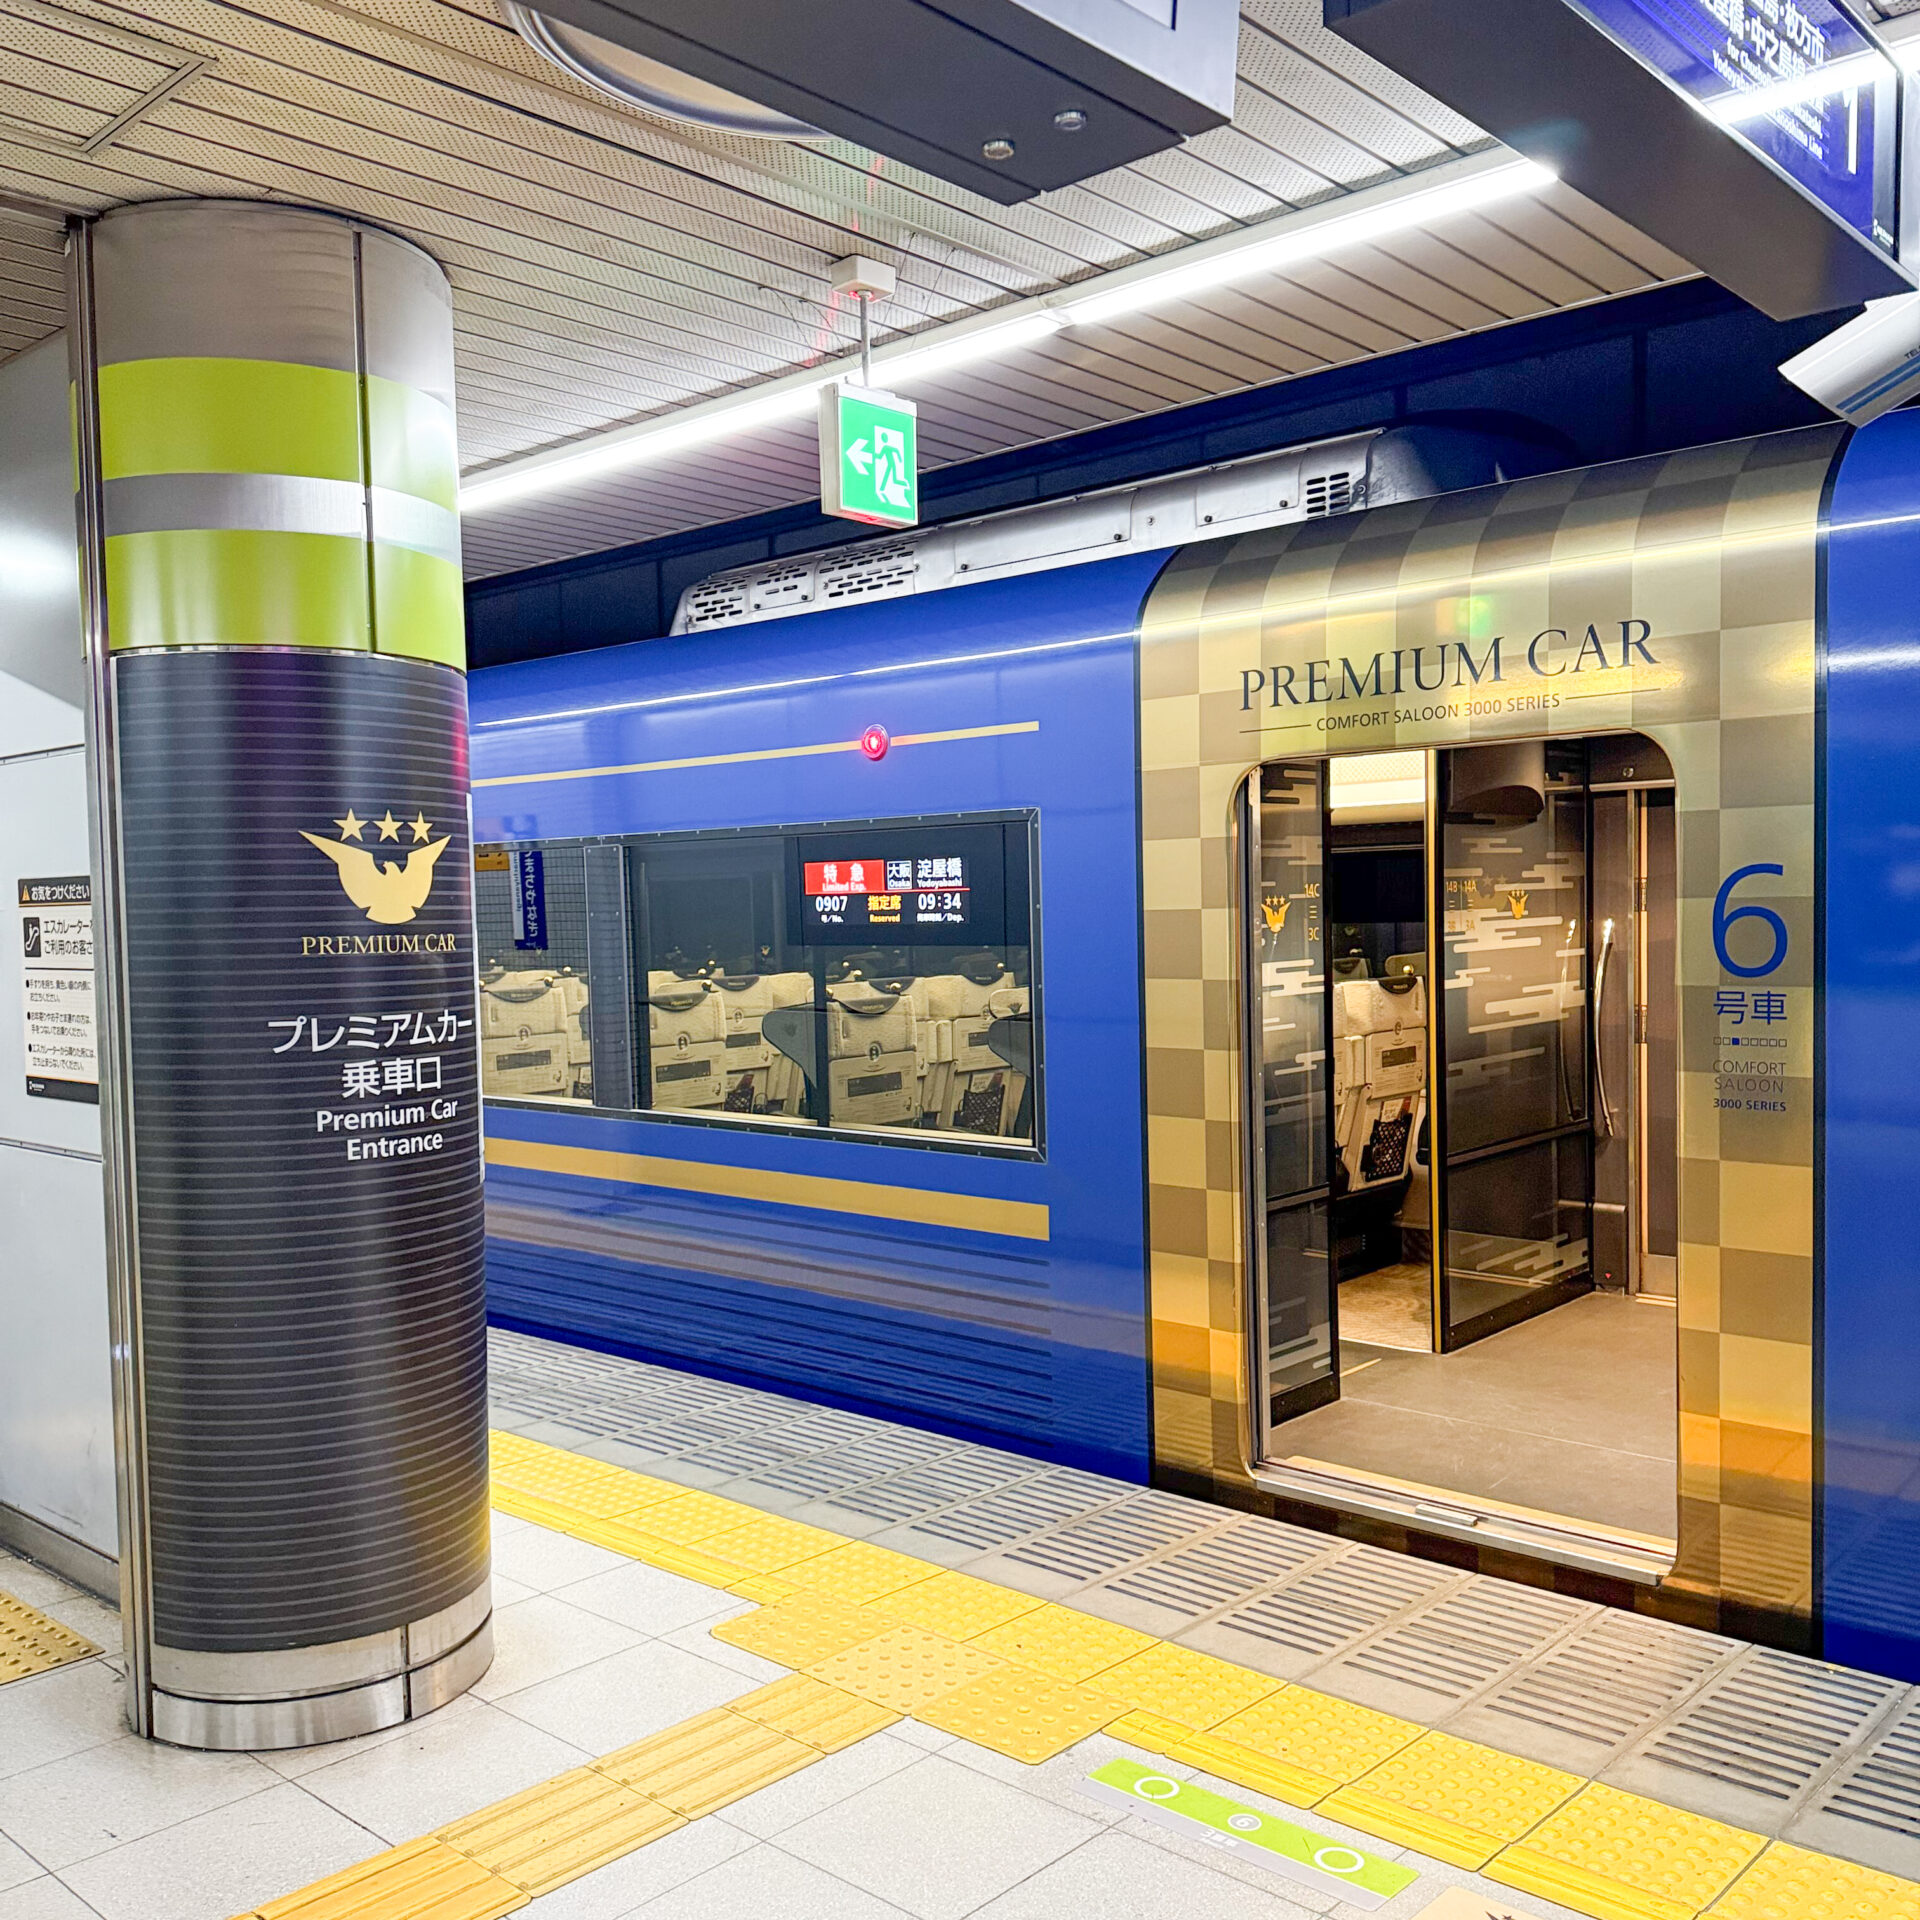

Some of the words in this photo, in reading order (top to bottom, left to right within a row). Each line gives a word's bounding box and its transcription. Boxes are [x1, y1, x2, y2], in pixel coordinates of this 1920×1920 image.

[1727, 36, 1740, 61] for
[1239, 636, 1507, 711] PREMIUM
[1527, 619, 1661, 677] CAR
[1316, 710, 1389, 732] COMFORT
[1394, 704, 1459, 725] SALOON
[1464, 699, 1502, 717] 3000
[1507, 693, 1560, 714] SERIES
[823, 862, 864, 882] 特急
[888, 862, 911, 877] 大阪
[917, 857, 962, 878] 淀屋橋
[822, 882, 849, 892] Limited
[850, 881, 866, 892] Exp.
[889, 879, 911, 889] Osaka
[917, 877, 963, 889] Yodoyabashi
[1304, 883, 1320, 898] 14C
[1464, 880, 1477, 892] 14A
[31, 884, 90, 901] お気をつけください
[815, 895, 848, 912] 0907
[868, 894, 902, 912] 指定席
[918, 893, 962, 911] 09:34
[869, 913, 900, 923] Reserved
[1712, 863, 1788, 978] 6
[1308, 926, 1320, 941] 3C
[302, 934, 421, 956] PREMIUM
[425, 932, 457, 952] CAR
[1713, 990, 1787, 1025] 号車
[267, 1009, 473, 1054] プレミアムカー
[1712, 1059, 1787, 1075] COMFORT
[341, 1056, 442, 1099] 乗車口
[1714, 1076, 1784, 1093] SALOON
[1713, 1098, 1742, 1110] 3000
[1746, 1099, 1787, 1112] SERIES
[316, 1103, 425, 1132] Premium
[430, 1099, 458, 1119] Car
[347, 1132, 443, 1161] Entrance
[1236, 1817, 1254, 1827] 6
